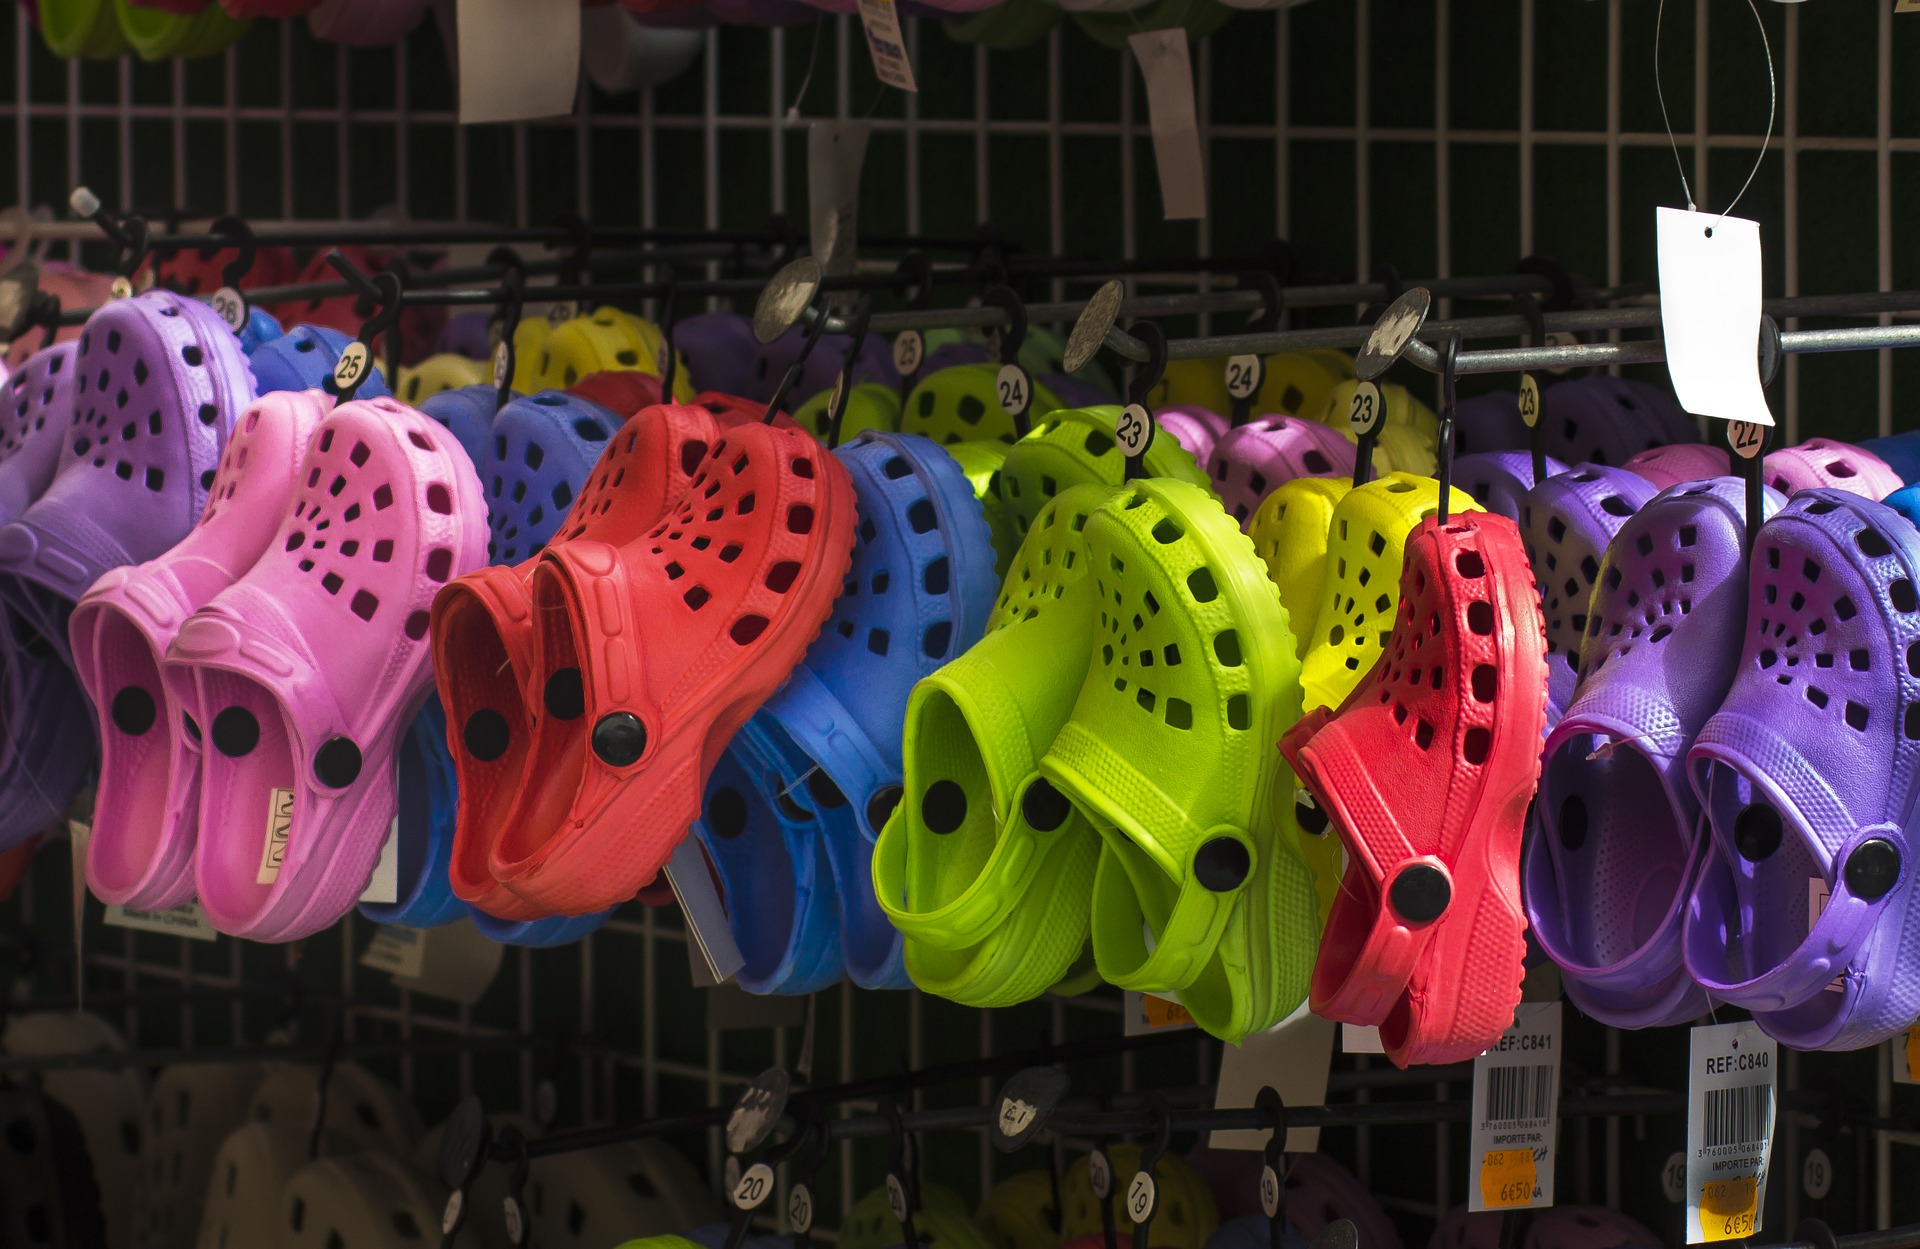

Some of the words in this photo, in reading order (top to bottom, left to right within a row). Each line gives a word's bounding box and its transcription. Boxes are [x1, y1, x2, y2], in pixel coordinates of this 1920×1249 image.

[337, 355, 361, 379] 25
[1229, 364, 1252, 391] 24
[1000, 379, 1022, 408] 24
[1520, 387, 1535, 416] 23
[1351, 395, 1373, 422] 23
[1116, 413, 1141, 448] 23
[1734, 422, 1758, 448] 22
[1706, 1051, 1769, 1075] REF:C840
[1494, 1134, 1525, 1145] IMPORTE
[1527, 1133, 1543, 1142] PAR:
[1668, 1165, 1685, 1190] 19
[1713, 1158, 1748, 1172] IMPORTE
[1808, 1162, 1824, 1188] 19
[739, 1178, 764, 1201] 20
[1131, 1182, 1148, 1214] 19
[1262, 1179, 1273, 1205] 19
[1501, 1182, 1531, 1201] 6€50
[792, 1194, 808, 1226] 20
[1724, 1214, 1754, 1236] 6€50
